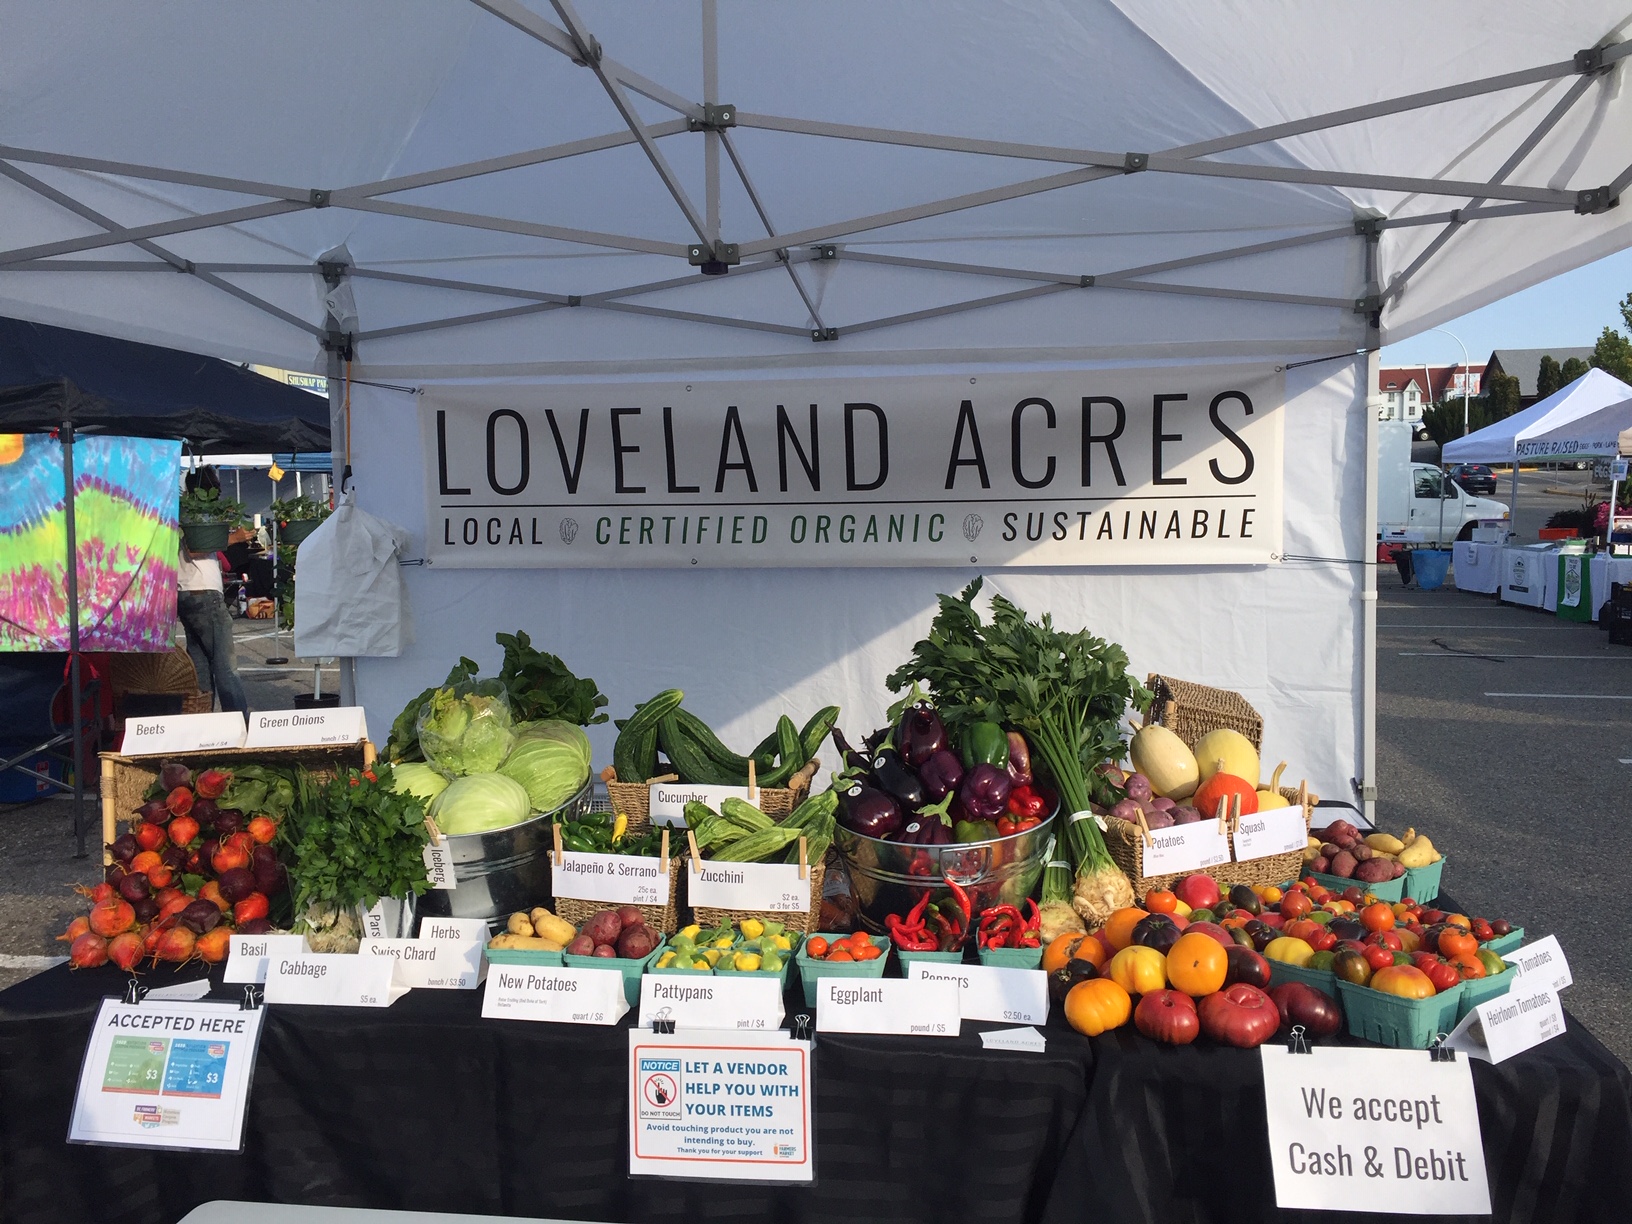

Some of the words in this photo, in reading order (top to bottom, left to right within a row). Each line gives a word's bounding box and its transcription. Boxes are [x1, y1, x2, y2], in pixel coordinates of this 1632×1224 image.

[436, 402, 889, 495] LOVELAND
[944, 390, 1256, 489] ACRES
[1516, 442, 1549, 455] PASTURE
[1552, 441, 1579, 454] RAISED
[444, 517, 543, 545] LOCAL
[595, 515, 769, 545] CERTIFIED
[790, 514, 945, 544] ORGANIC
[1002, 508, 1256, 541] SUSTAINABLE
[260, 716, 289, 728] Green
[292, 714, 325, 726] Onions
[136, 724, 165, 736] Beets
[658, 790, 708, 803] Cucumber
[1240, 820, 1265, 836] Squash
[1151, 834, 1185, 850] Potatoes
[431, 849, 446, 883] Iceberg
[562, 859, 603, 876] Jalapeño
[608, 862, 615, 875] &
[618, 862, 657, 878] Serrano
[700, 868, 744, 884] Zucchini
[782, 893, 789, 901] $2
[791, 902, 800, 910] $5
[369, 914, 381, 938] Pars
[431, 925, 460, 940] Herbs
[240, 942, 267, 956] Basil
[404, 946, 436, 961] Chard
[1519, 951, 1552, 972] Tomatoes
[280, 960, 327, 979] Cabbage
[498, 973, 523, 989] New
[527, 974, 577, 992] Potatoes
[360, 995, 369, 1003] $5
[654, 983, 713, 1002] Pattypans
[830, 986, 883, 1004] Eggplant
[571, 1012, 589, 1021] quart
[594, 1012, 603, 1021] $6
[1003, 1010, 1022, 1020] $2.50
[1486, 1003, 1518, 1028] Heirloom
[1516, 992, 1551, 1014] Tomatoes
[108, 1014, 195, 1031] ACCEPTED
[199, 1019, 246, 1034] HERE
[737, 1019, 749, 1029] pint
[755, 1019, 765, 1028] $4
[910, 1024, 930, 1033] pound
[936, 1024, 946, 1033] $5
[642, 1061, 679, 1070] NOTICE
[685, 1062, 709, 1074] LET
[713, 1062, 723, 1074] A
[727, 1063, 788, 1076] VENDOR
[146, 1069, 157, 1080] $3
[206, 1073, 218, 1084] $3
[685, 1083, 721, 1095] HELP
[724, 1083, 756, 1096] YOU
[760, 1085, 799, 1097] WITH
[685, 1103, 726, 1116] YOUR
[730, 1105, 773, 1117] ITEMS
[1301, 1087, 1342, 1119] We
[1353, 1095, 1443, 1130] accept
[646, 1123, 669, 1131] Avoid
[672, 1124, 708, 1134] touching
[710, 1125, 743, 1135] product
[745, 1128, 761, 1136] you
[779, 1127, 794, 1135] not
[684, 1136, 724, 1146] intending
[726, 1137, 735, 1145] to
[737, 1137, 755, 1147] buy.
[1289, 1142, 1353, 1177] Cash
[1364, 1146, 1384, 1178] &
[1394, 1147, 1469, 1181] Debit
